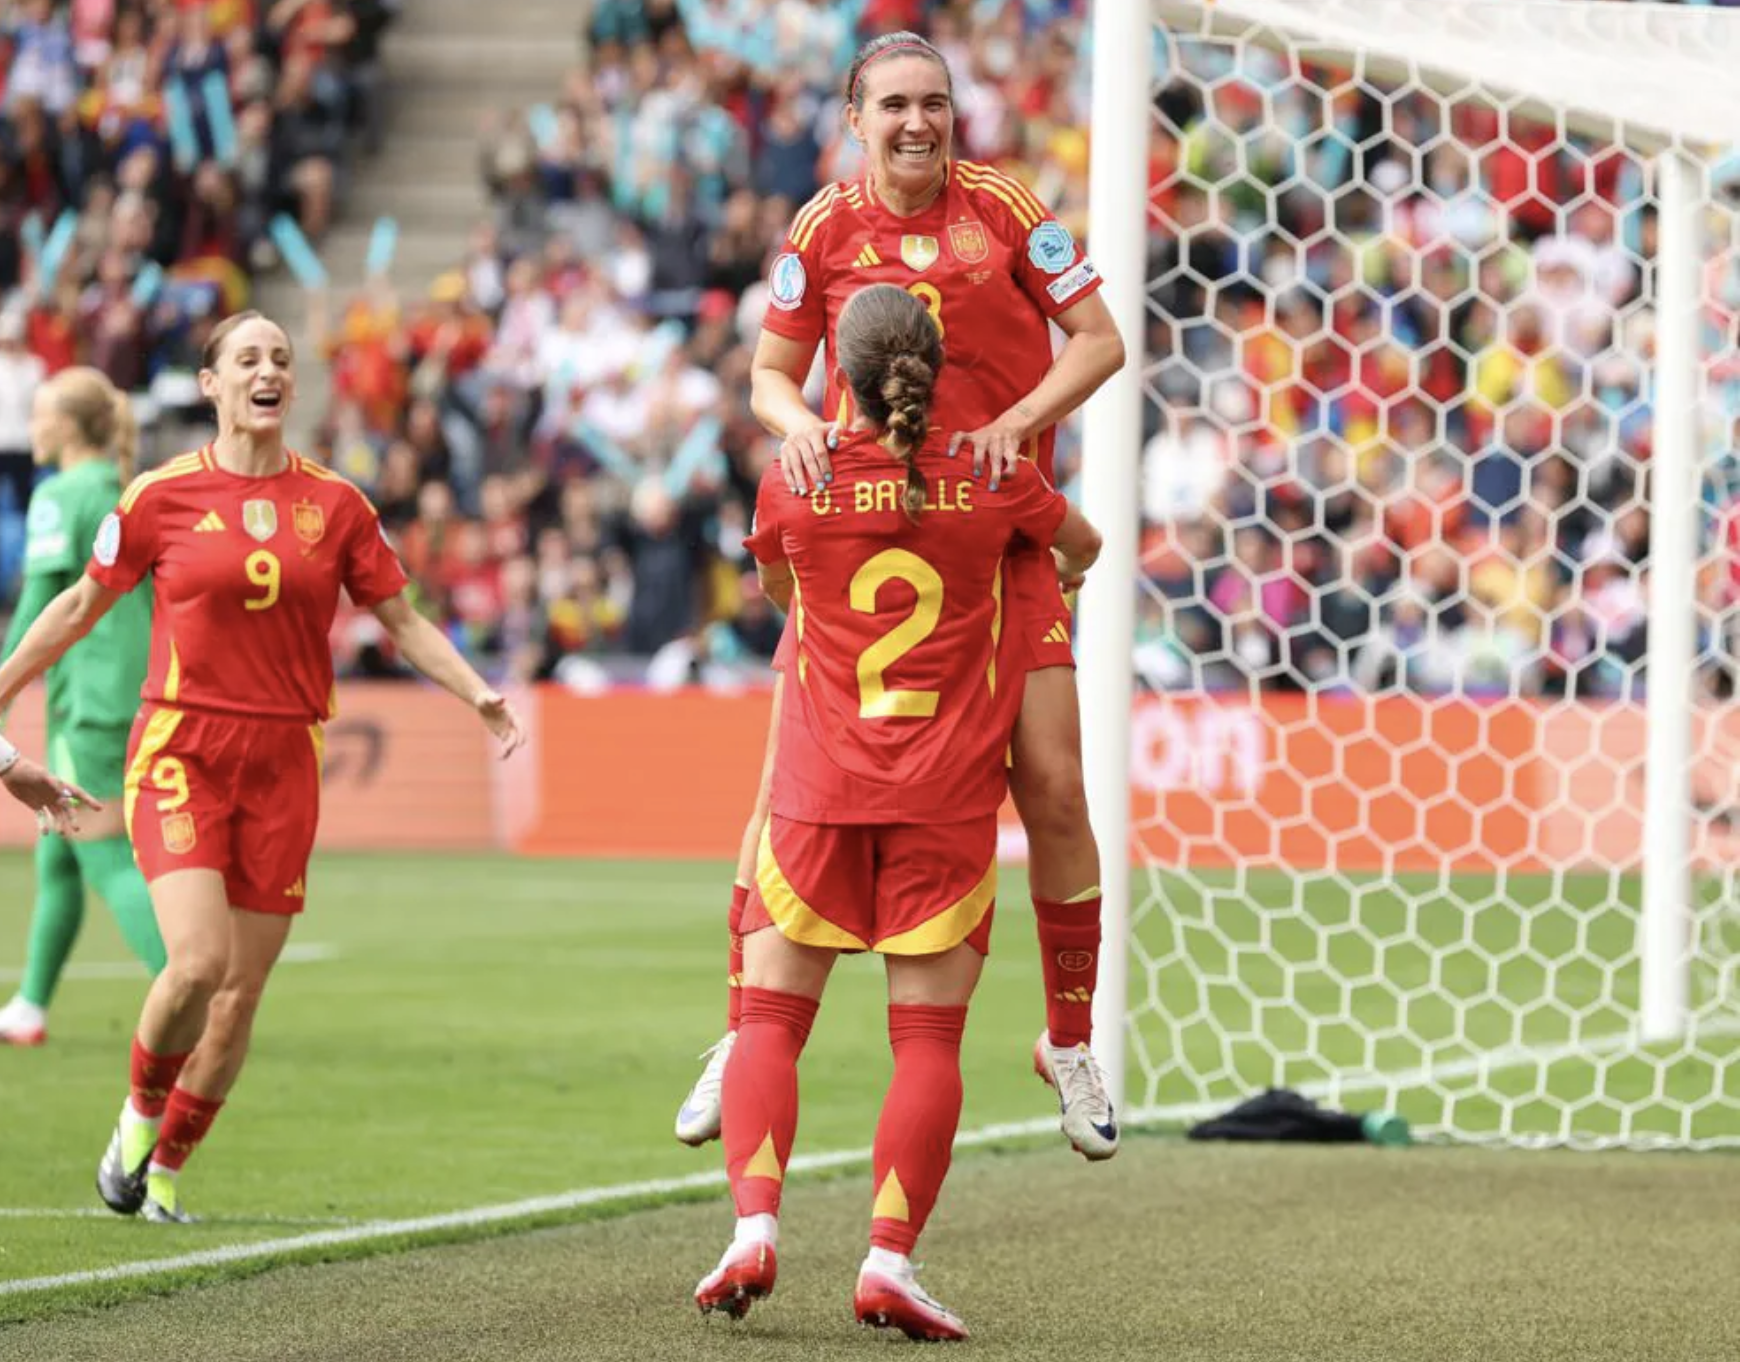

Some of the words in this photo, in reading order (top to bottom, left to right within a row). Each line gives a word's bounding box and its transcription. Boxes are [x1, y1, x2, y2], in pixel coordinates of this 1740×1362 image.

[854, 480, 973, 512] BALE
[244, 549, 281, 610] 9
[849, 548, 943, 718] 2
[151, 756, 190, 811] 9
